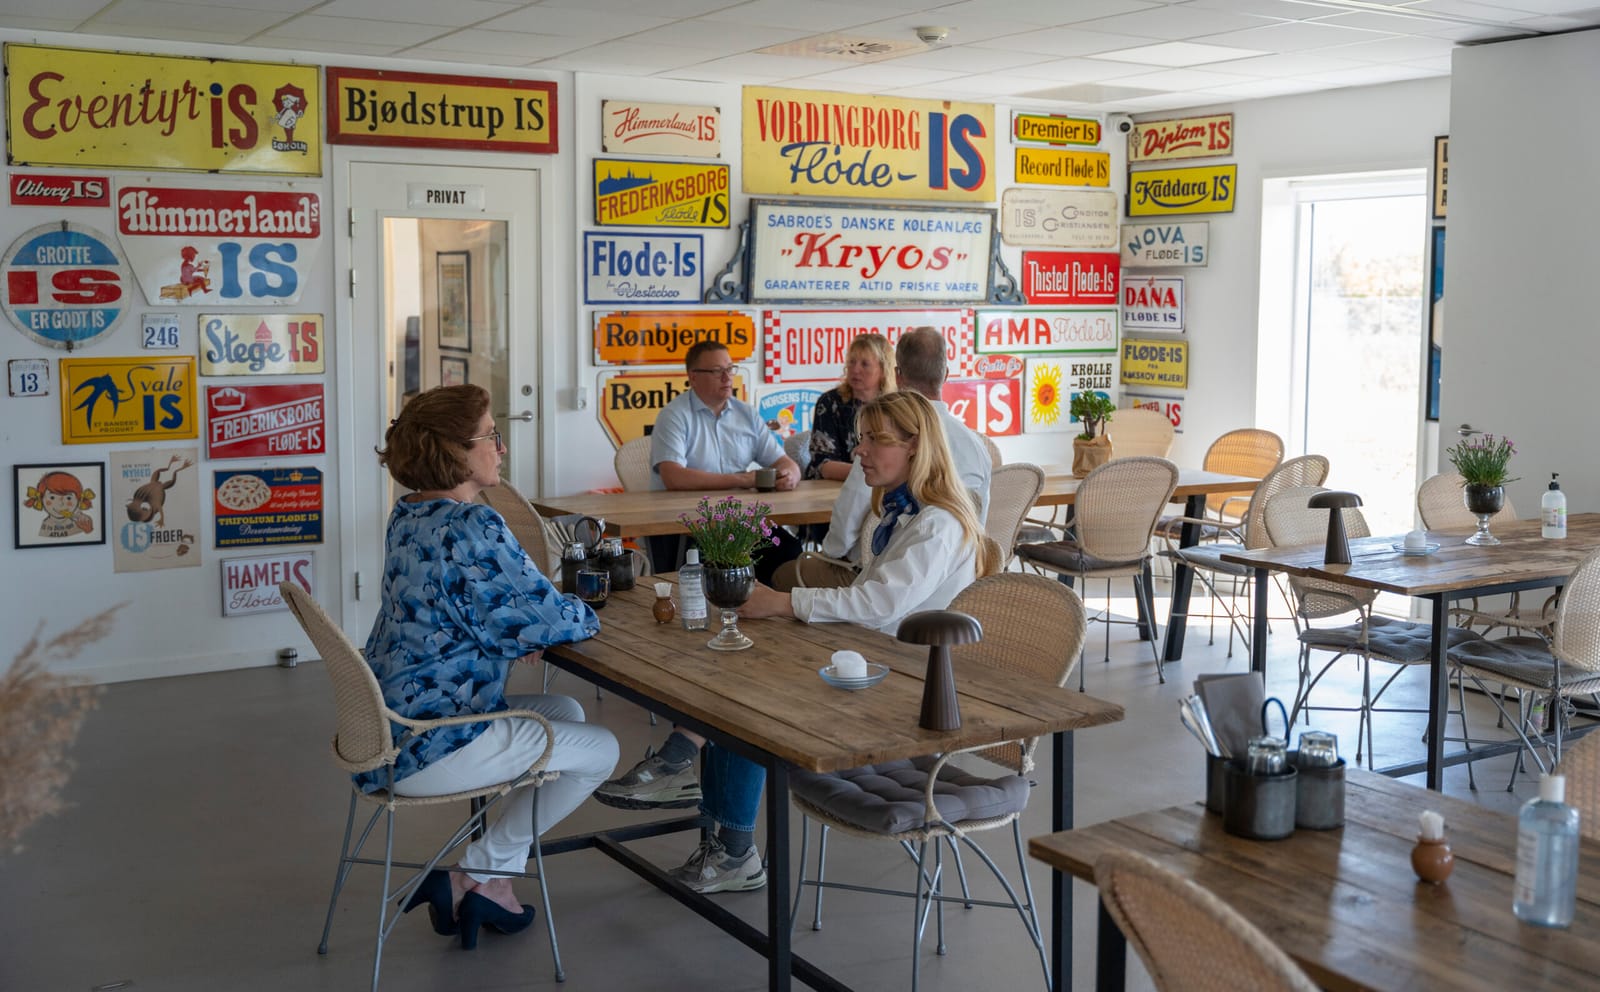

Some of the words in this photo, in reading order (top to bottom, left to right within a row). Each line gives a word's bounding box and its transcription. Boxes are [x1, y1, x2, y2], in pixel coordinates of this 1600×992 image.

[23, 72, 201, 140] Eventyr
[344, 86, 504, 139] Bjødstrup
[513, 97, 545, 131] IS
[612, 107, 696, 138] Himmerlands
[697, 115, 715, 141] IS
[1022, 118, 1080, 140] Premier
[1083, 124, 1094, 141] Is
[757, 99, 920, 151] VORDINGBORG
[928, 111, 987, 192] IS
[1143, 123, 1206, 157] Diplom
[1208, 120, 1230, 151] IS
[1020, 154, 1062, 177] Record
[1065, 158, 1093, 179] Fløde
[1097, 160, 1107, 179] IS
[16, 178, 71, 203] Viborg
[72, 180, 104, 200] IS
[427, 190, 466, 205] PRIVAT
[599, 167, 727, 223] FREDERIKSBORG
[1135, 179, 1210, 208] Kaddara
[1211, 175, 1231, 202] IS
[701, 193, 727, 224] IS
[1015, 209, 1036, 228] IS
[841, 215, 895, 231] DANSKE
[903, 218, 983, 234] KØLEANLÆG
[1042, 218, 1110, 232] CHRISTIANSEN
[1127, 226, 1185, 257] NOVA
[37, 246, 92, 265] GROTTE
[218, 242, 297, 299] IS
[1028, 260, 1070, 297] Thisted
[8, 269, 122, 305] IS
[764, 280, 850, 291] GARANTERER
[859, 281, 893, 292] ALTID
[900, 281, 940, 292] FRISKE
[945, 282, 979, 293] VARER
[1124, 287, 1178, 309] DANA
[30, 312, 49, 330] ER
[52, 311, 88, 329] GODT
[91, 310, 105, 328] IS
[1124, 311, 1160, 323] FLØDE
[1163, 312, 1177, 323] IS
[145, 327, 179, 346] 246
[725, 321, 748, 345] Is
[985, 318, 1052, 345] AMA
[205, 319, 285, 372] Stege
[288, 321, 319, 363] IS
[1070, 363, 1112, 376] KRØLLE
[20, 373, 38, 393] 13
[107, 366, 183, 402] Svale
[143, 394, 184, 431] IS
[976, 382, 1013, 434] IS
[1166, 403, 1181, 427] IS
[213, 401, 320, 442] FREDERIKSBORG
[268, 427, 321, 453] FLØDE-IS
[218, 516, 275, 526] TRIFOLIUM
[308, 513, 319, 521] IS
[150, 529, 184, 544] FRØER
[227, 562, 282, 590] HAME
